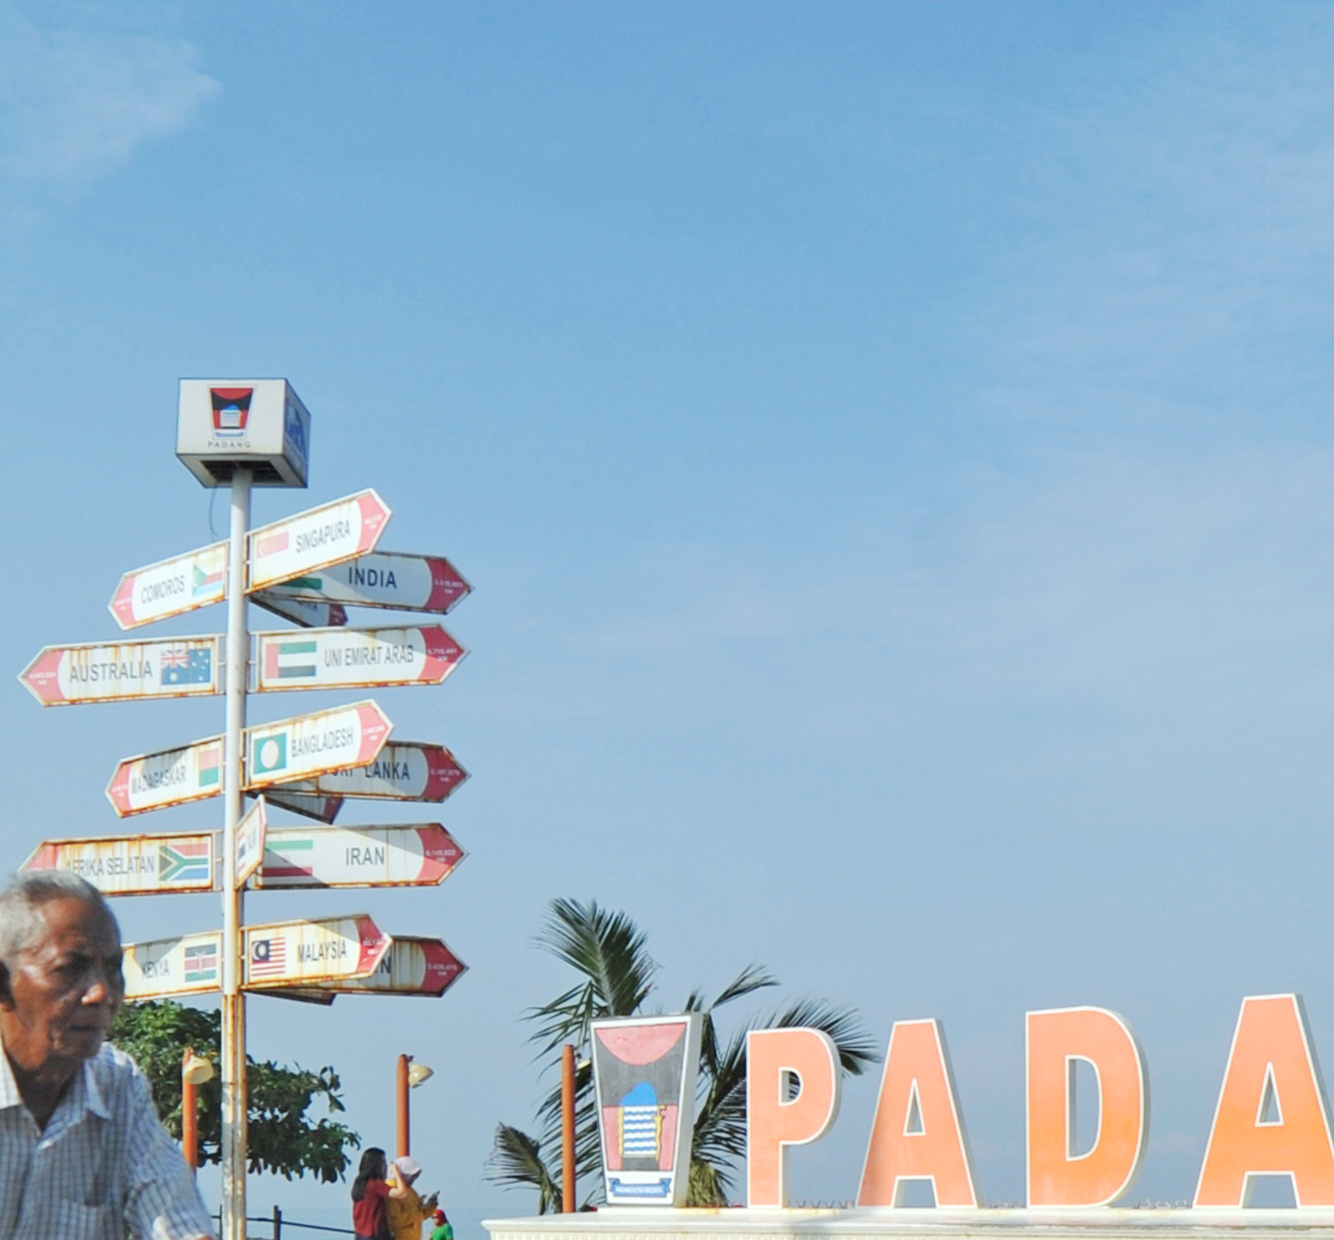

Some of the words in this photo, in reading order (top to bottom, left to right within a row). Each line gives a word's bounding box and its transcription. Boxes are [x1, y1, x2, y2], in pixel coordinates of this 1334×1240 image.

[295, 519, 351, 553] SINGAPURA
[348, 566, 397, 589] INDIA
[140, 575, 186, 604] COMOROS
[324, 649, 342, 667] UNI
[344, 646, 382, 666] EMIRAT
[384, 644, 414, 664] ARAB
[69, 660, 153, 684] AUSTRALIA
[291, 726, 354, 758] BANGLADESH
[364, 761, 411, 780] LANKA
[107, 855, 154, 875] SELATAN
[345, 847, 385, 866] IRAN
[297, 940, 347, 963] MALAYSIA
